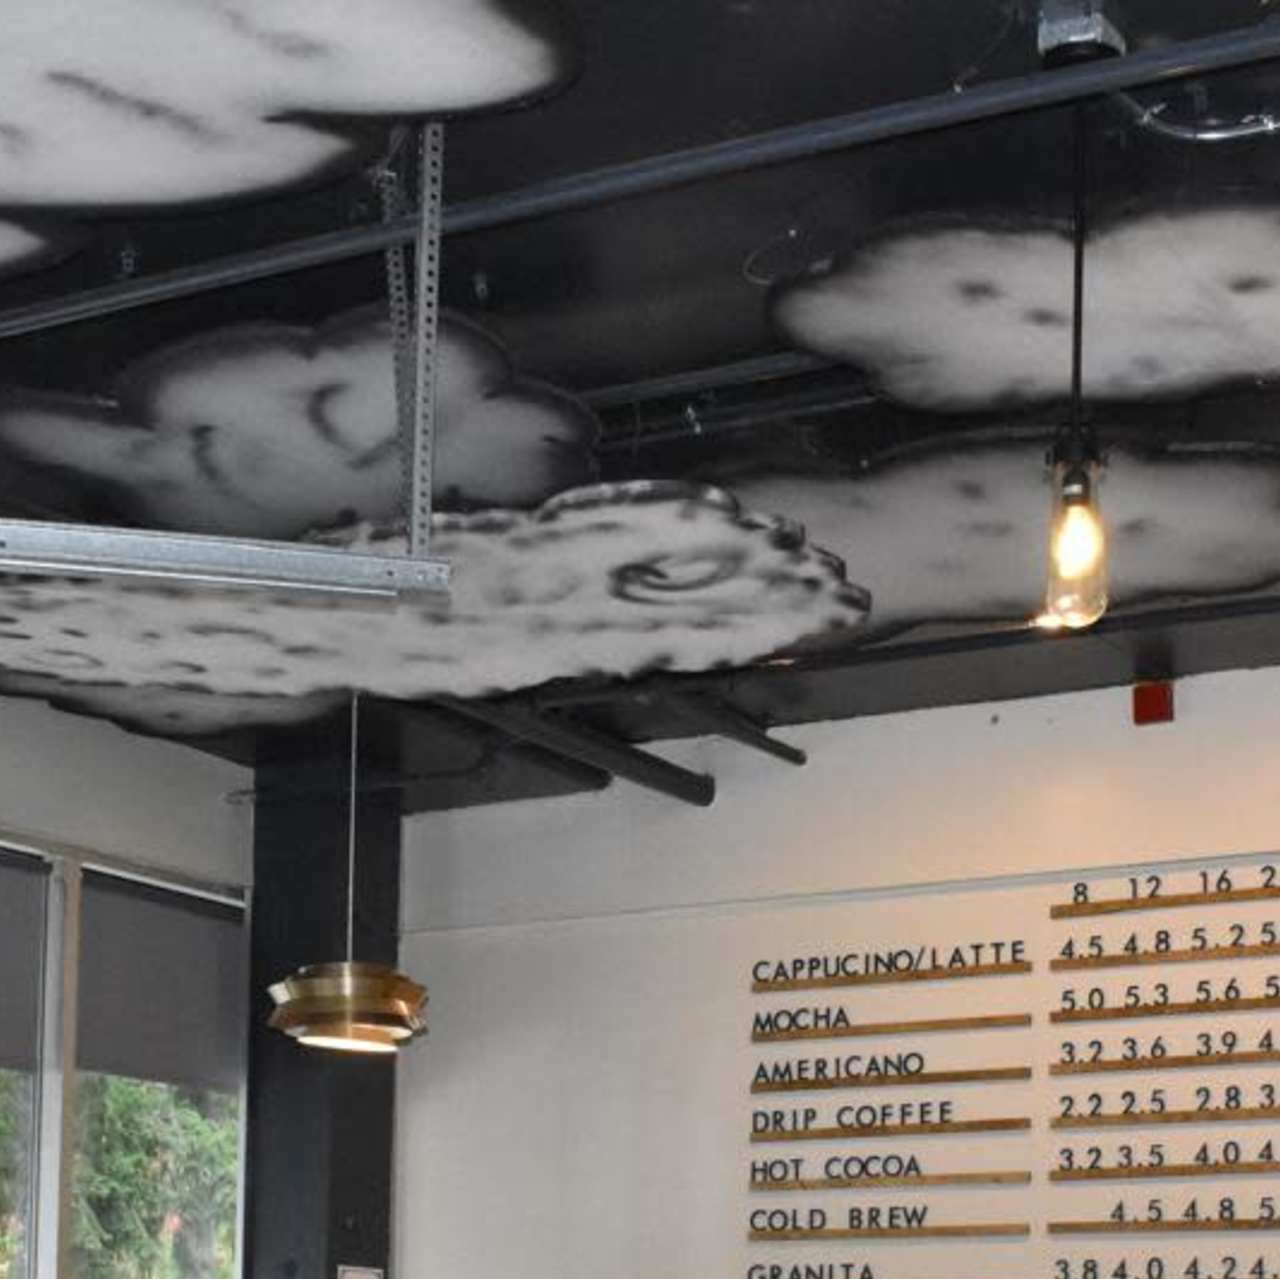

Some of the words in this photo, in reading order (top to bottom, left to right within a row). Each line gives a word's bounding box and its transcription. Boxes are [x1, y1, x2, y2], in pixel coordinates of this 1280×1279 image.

[1073, 882, 1088, 903] 8
[1128, 876, 1161, 900] 12
[1199, 870, 1233, 895] 16
[752, 940, 1025, 983] CAPPUCINO/LATTE
[1061, 935, 1104, 959] 4.5
[1124, 930, 1170, 954] 4.8
[1192, 924, 1244, 950] 5.2
[753, 1006, 851, 1032] MOCHA
[1062, 988, 1104, 1012] 5.0
[1125, 983, 1169, 1009] 5.3
[1196, 978, 1240, 1003] 5.6
[753, 1052, 924, 1084] AMERICANO
[1061, 1040, 1103, 1064] 3.2
[1123, 1036, 1166, 1061] 3.6
[1196, 1031, 1237, 1056] 3.9
[752, 1107, 817, 1133] DRIP
[837, 1101, 953, 1129] COFFEE
[1061, 1093, 1103, 1118] 2.2
[1121, 1089, 1165, 1115] 2.5
[1196, 1086, 1241, 1112] 2.8
[750, 1159, 803, 1182] HOT
[824, 1154, 921, 1180] COCOA
[1060, 1147, 1102, 1171] 3.2
[1118, 1144, 1164, 1168] 3.5
[1194, 1141, 1240, 1165] 4.0
[750, 1209, 826, 1232] COLD
[849, 1205, 928, 1229] BREW
[1111, 1199, 1163, 1223] 4.5
[1183, 1197, 1235, 1223] 4.8
